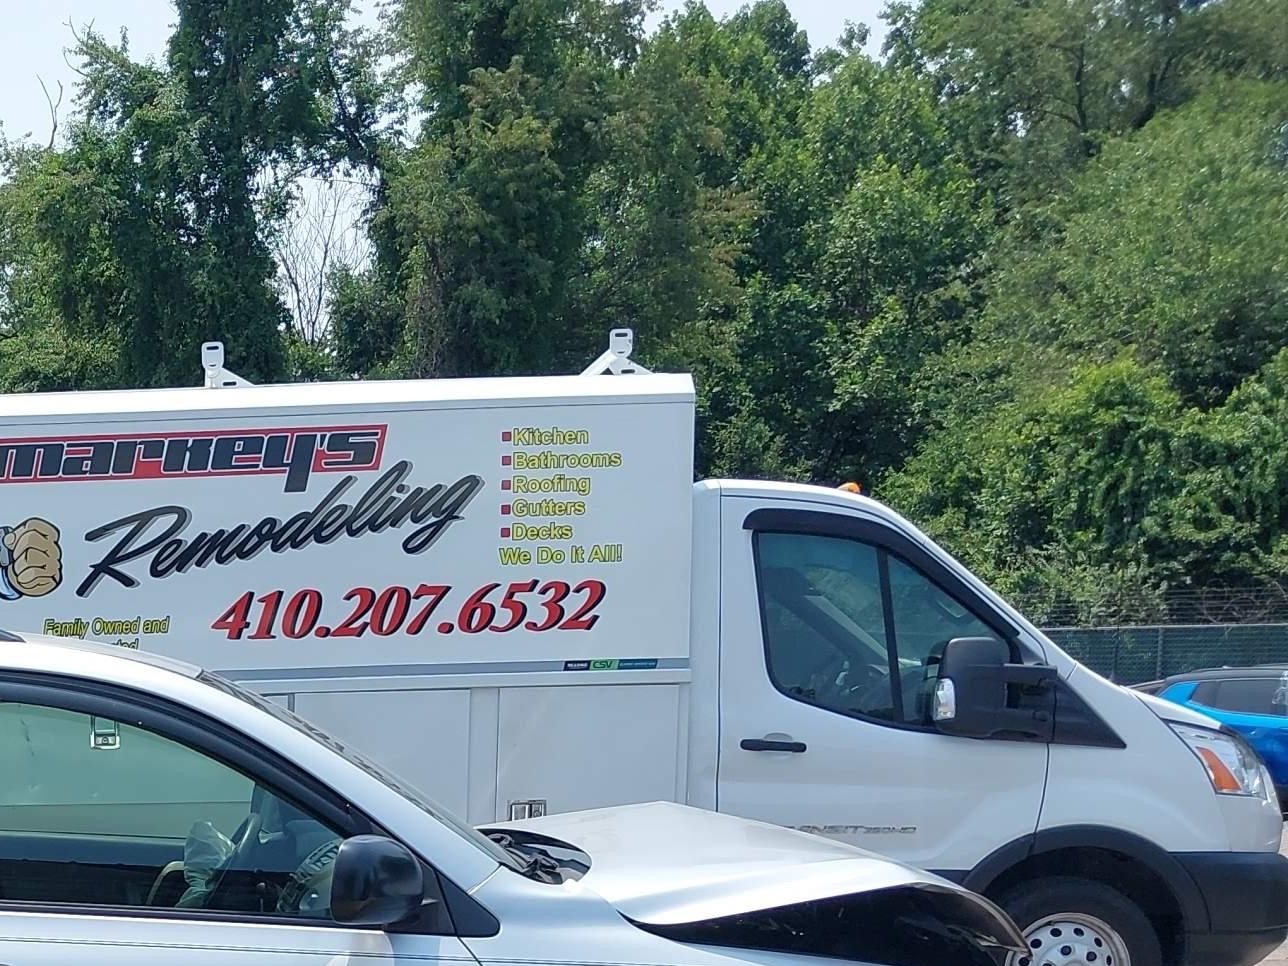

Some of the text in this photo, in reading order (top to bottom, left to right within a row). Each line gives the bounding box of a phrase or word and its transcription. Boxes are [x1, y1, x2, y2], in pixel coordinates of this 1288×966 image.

[513, 427, 589, 446] Kitchen
[513, 451, 622, 470] Bathrooms
[512, 474, 591, 496] Roofing
[512, 498, 586, 517] Gutters
[76, 460, 486, 598] Remodeling
[512, 522, 573, 540] Decks
[499, 544, 623, 565] We Do It All!
[211, 579, 607, 641] 410.207.6532
[43, 615, 171, 640] Family Owned and
[592, 660, 613, 670] CSV
